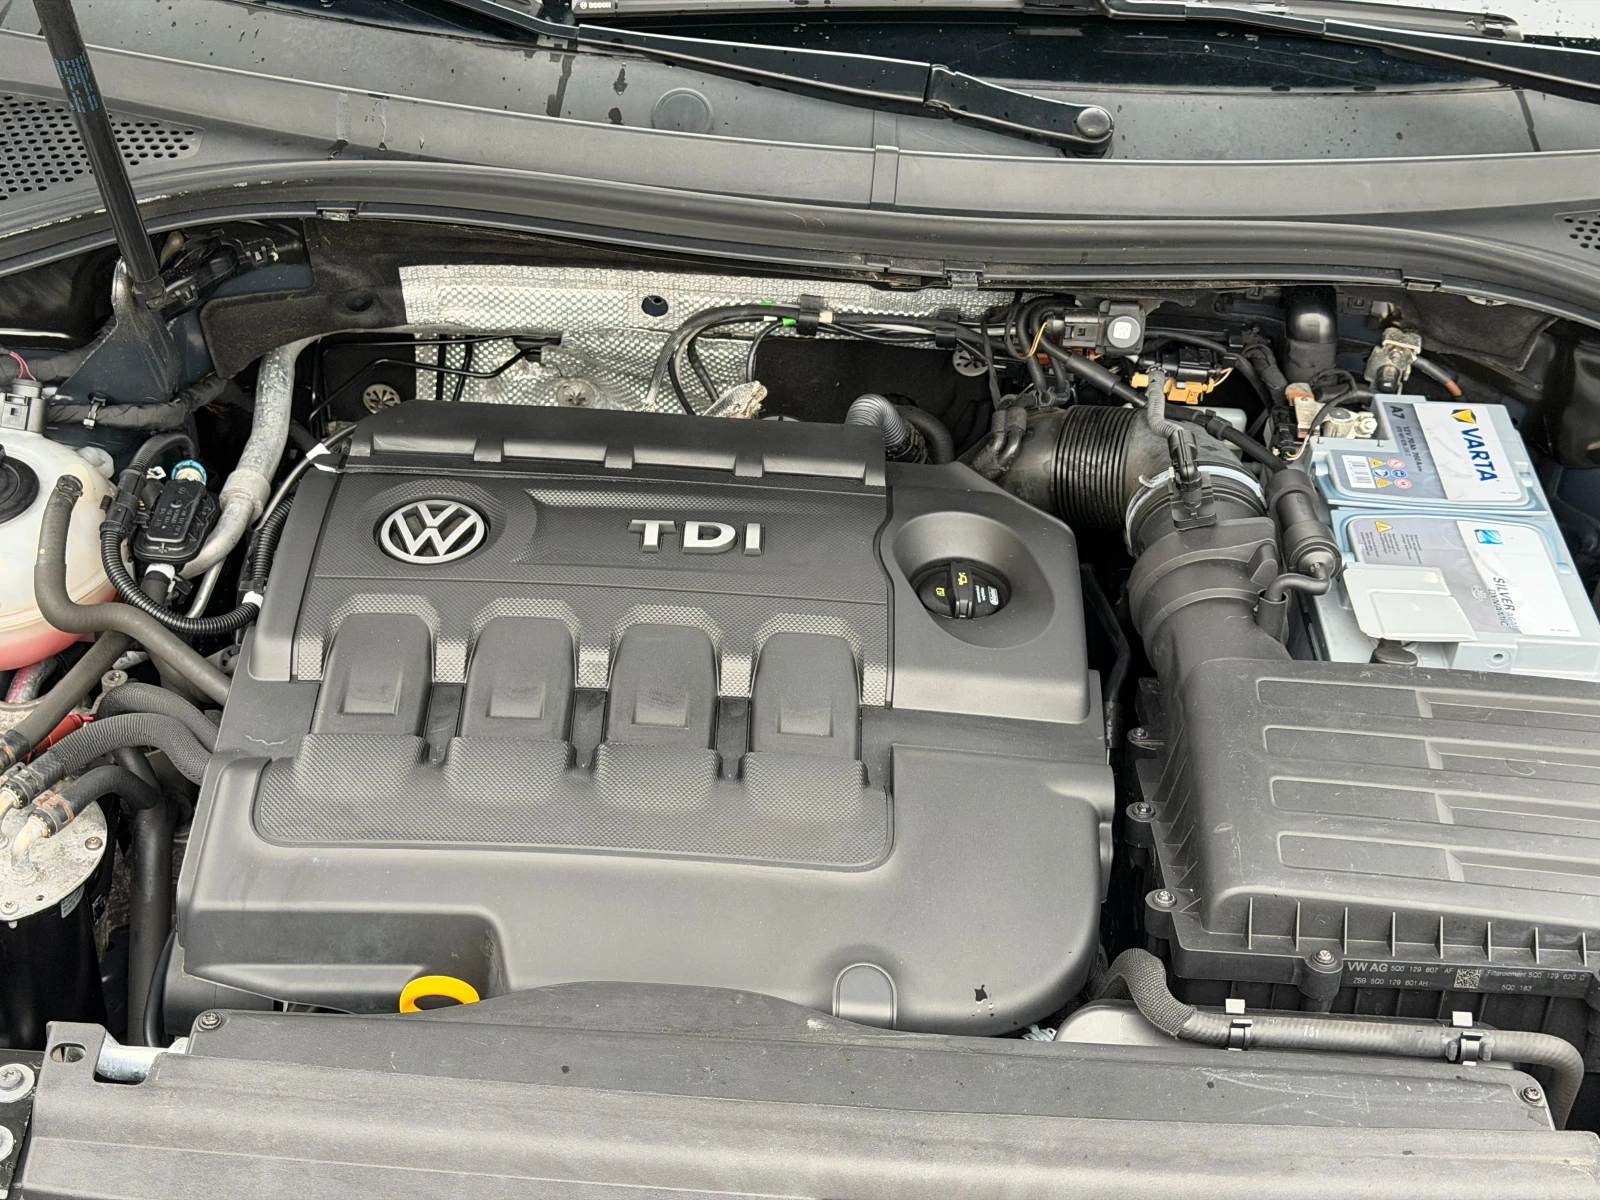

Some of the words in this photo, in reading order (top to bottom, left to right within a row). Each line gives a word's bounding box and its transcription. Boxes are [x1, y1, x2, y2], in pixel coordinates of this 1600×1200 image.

[1389, 405, 1405, 419] A7
[1460, 427, 1498, 481] VARTA
[628, 519, 765, 555] TDI
[1493, 577, 1516, 611] SILVER
[1347, 961, 1368, 971] VW
[1369, 962, 1388, 972] AG
